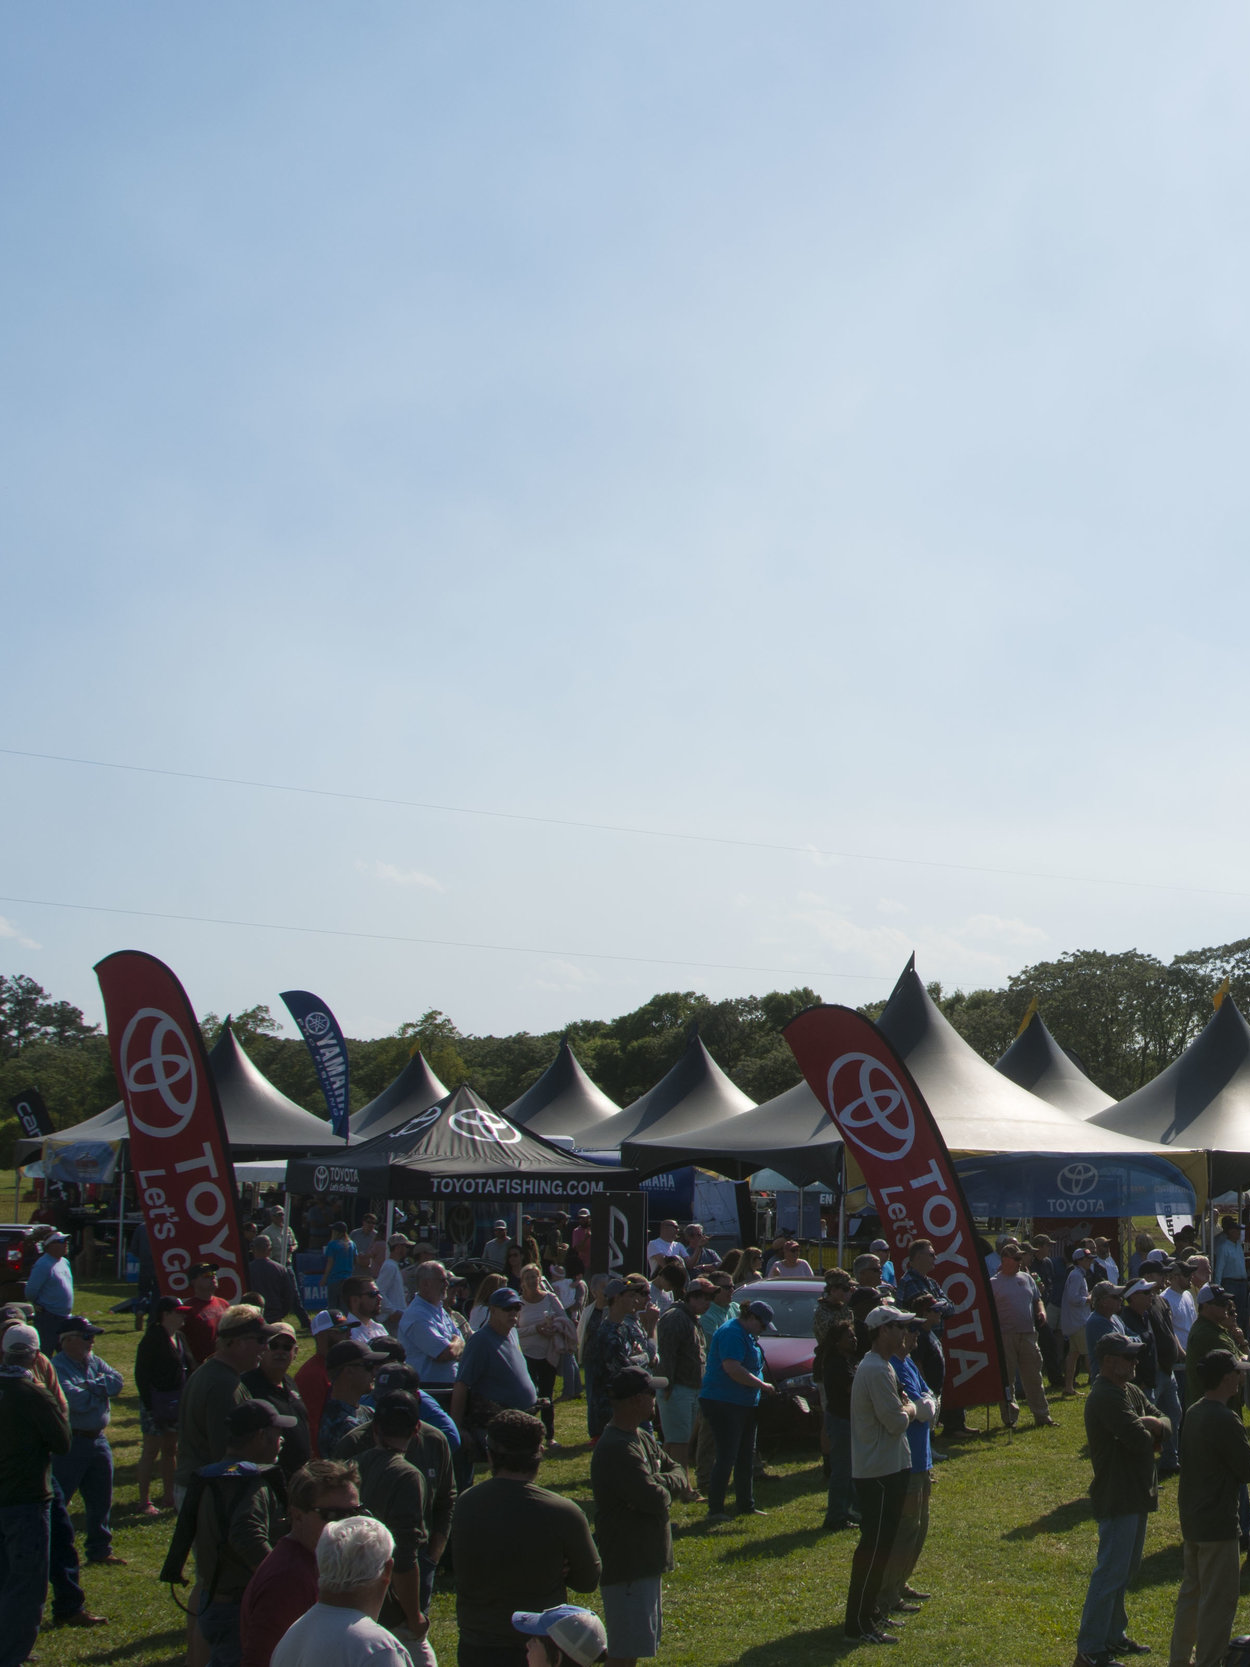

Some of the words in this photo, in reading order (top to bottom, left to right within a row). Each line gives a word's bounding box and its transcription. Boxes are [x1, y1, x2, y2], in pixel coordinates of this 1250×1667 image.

[330, 1167, 360, 1183] TOYOTA
[430, 1178, 604, 1197] TOYOTAFISHING.COM
[880, 1185, 914, 1253] Let's
[1047, 1199, 1105, 1212] TOYOTA
[138, 1169, 180, 1239] Let's
[161, 1247, 191, 1290] Go
[909, 1158, 989, 1389] TOYOTA
